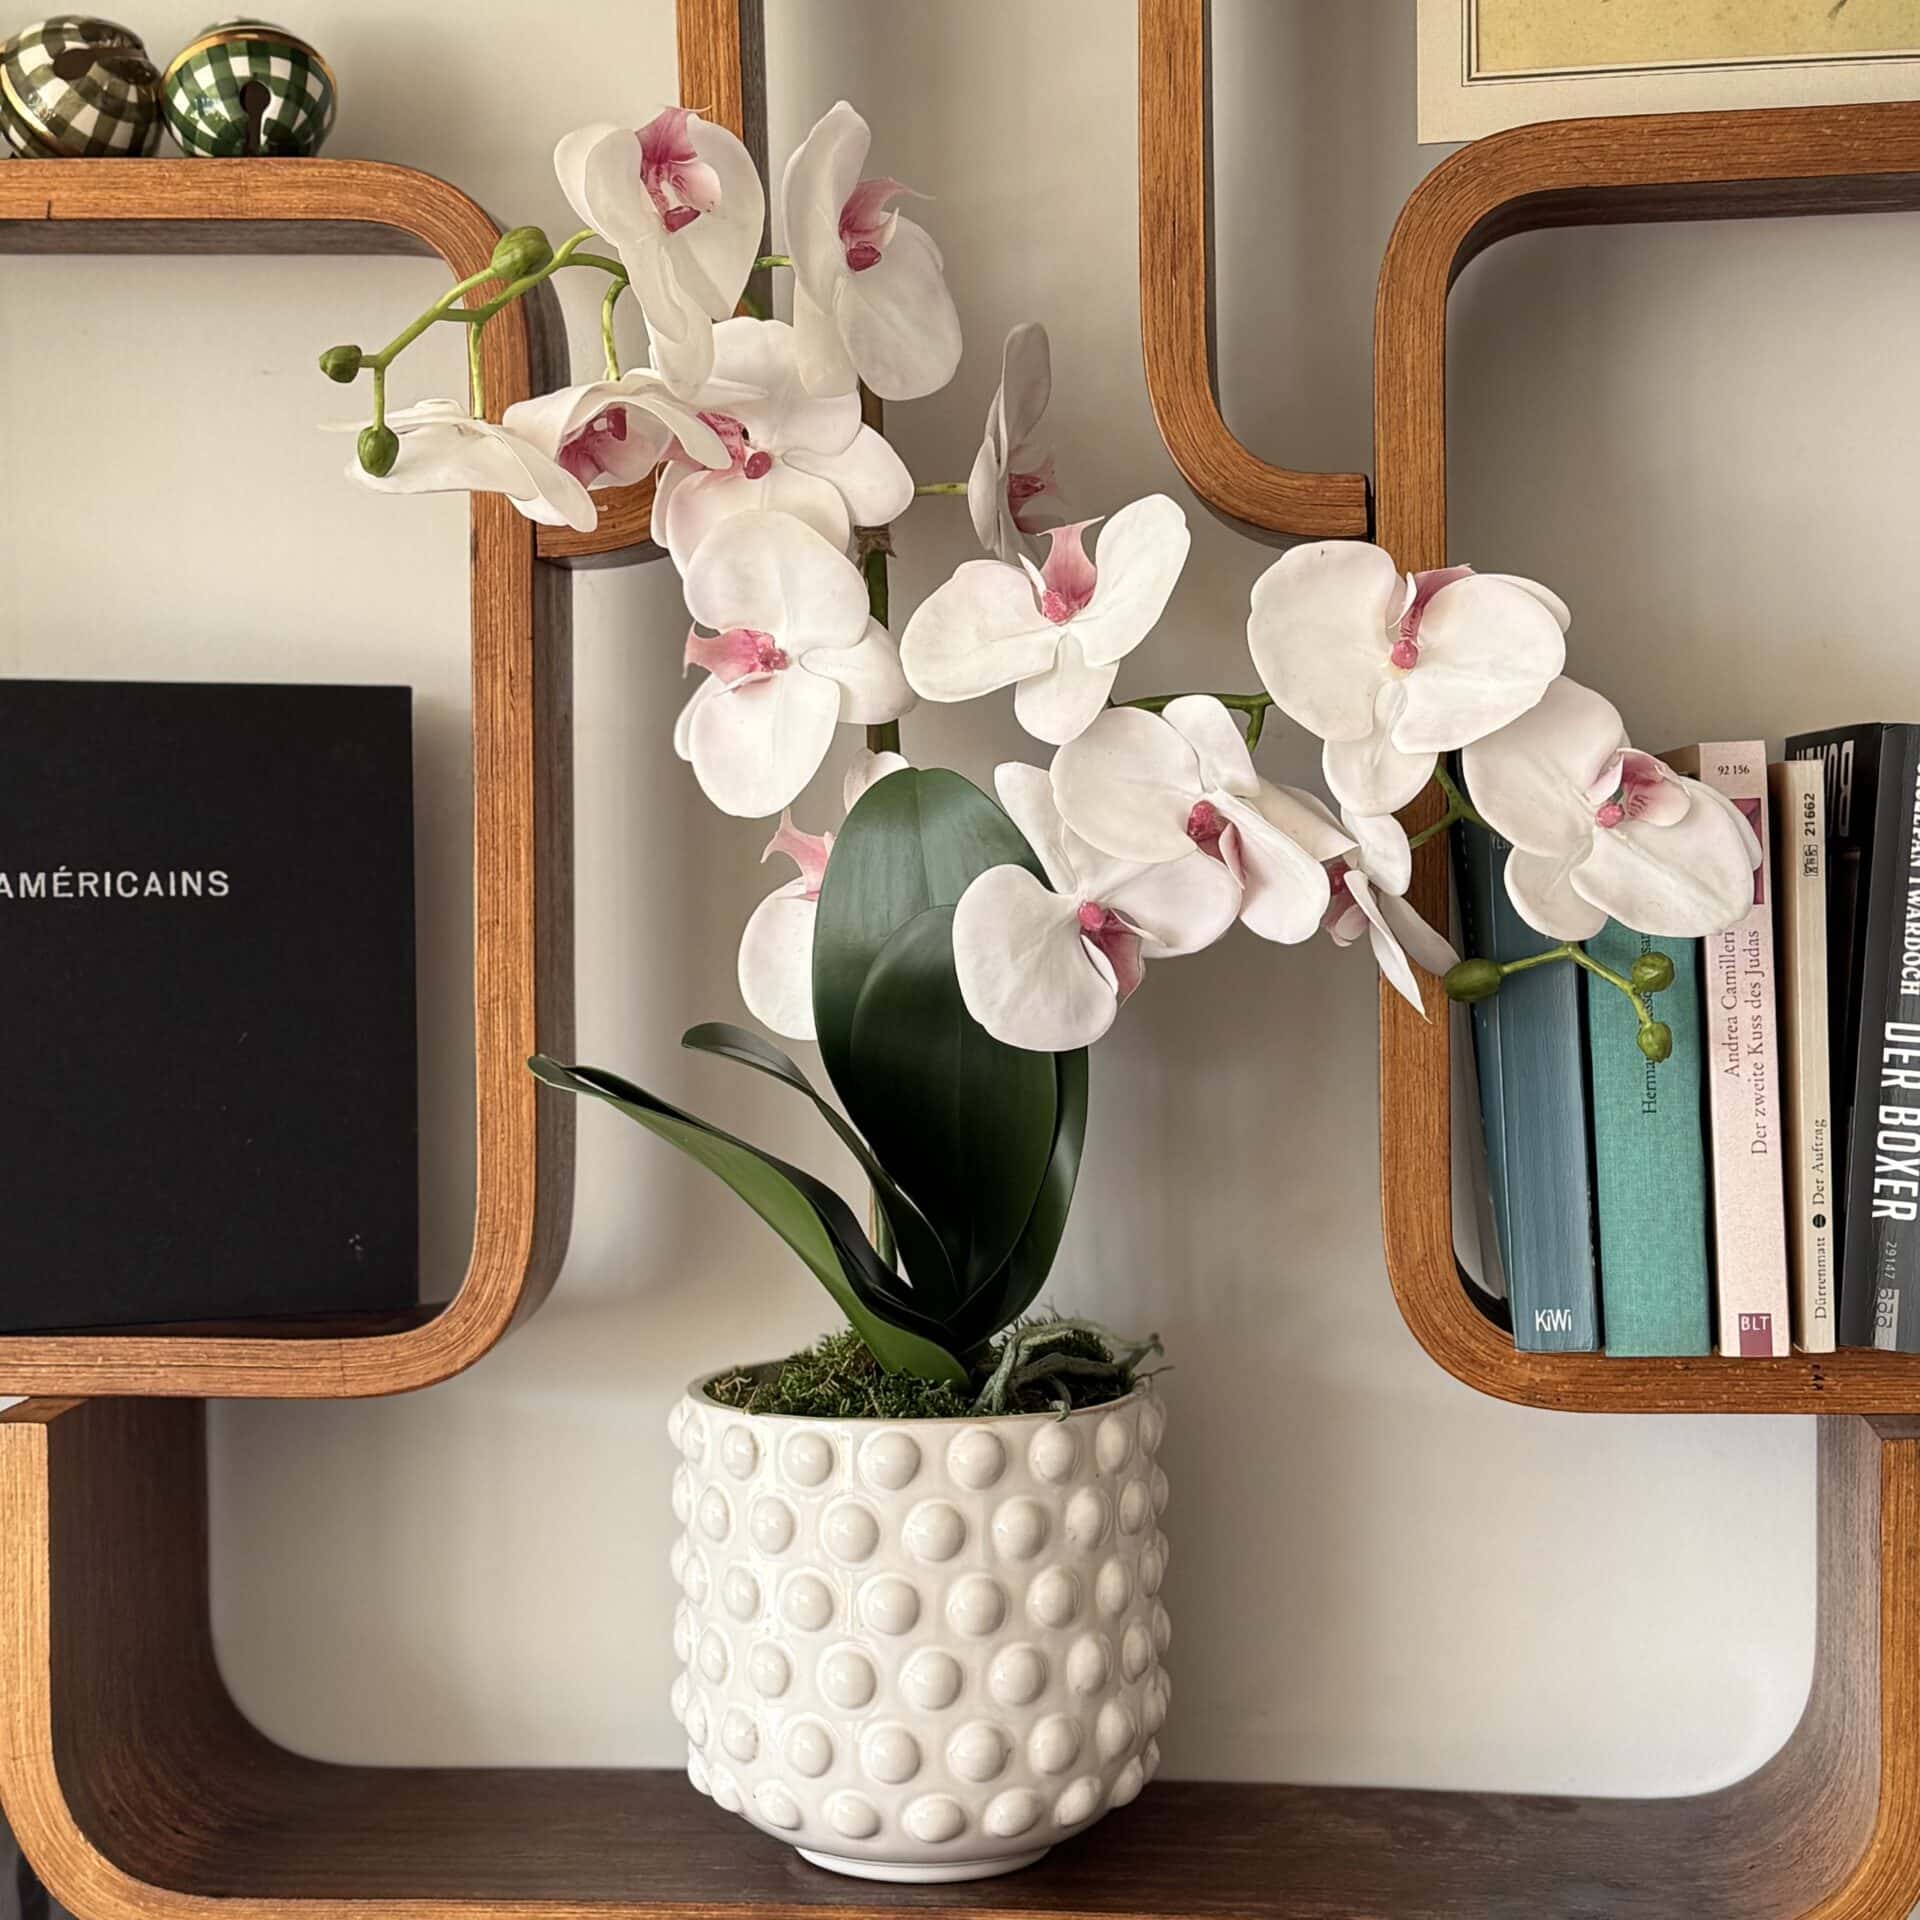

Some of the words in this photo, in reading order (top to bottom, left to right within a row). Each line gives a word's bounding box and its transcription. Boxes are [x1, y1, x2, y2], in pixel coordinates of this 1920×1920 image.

[1718, 764, 1730, 776] 92
[1733, 764, 1750, 776] 156
[1803, 792, 1816, 837] 21662
[0, 865, 229, 898] AMÉRICAINS
[1742, 930, 1765, 978] Judas
[1744, 981, 1762, 1009] des
[1721, 1016, 1741, 1078] Andrea
[1747, 1013, 1764, 1057] Kuss
[1880, 1021, 1920, 1090] DER
[1747, 1061, 1767, 1117] zweite
[1750, 1118, 1768, 1155] Der
[1811, 1118, 1827, 1174] Auftrag
[1872, 1104, 1920, 1222] BOXER
[1812, 1178, 1825, 1206] Der
[1814, 1236, 1827, 1320] Dürrenmatt
[1884, 1240, 1897, 1280] 29147
[1535, 1309, 1572, 1332] KiWi
[1740, 1315, 1770, 1331] BLT
